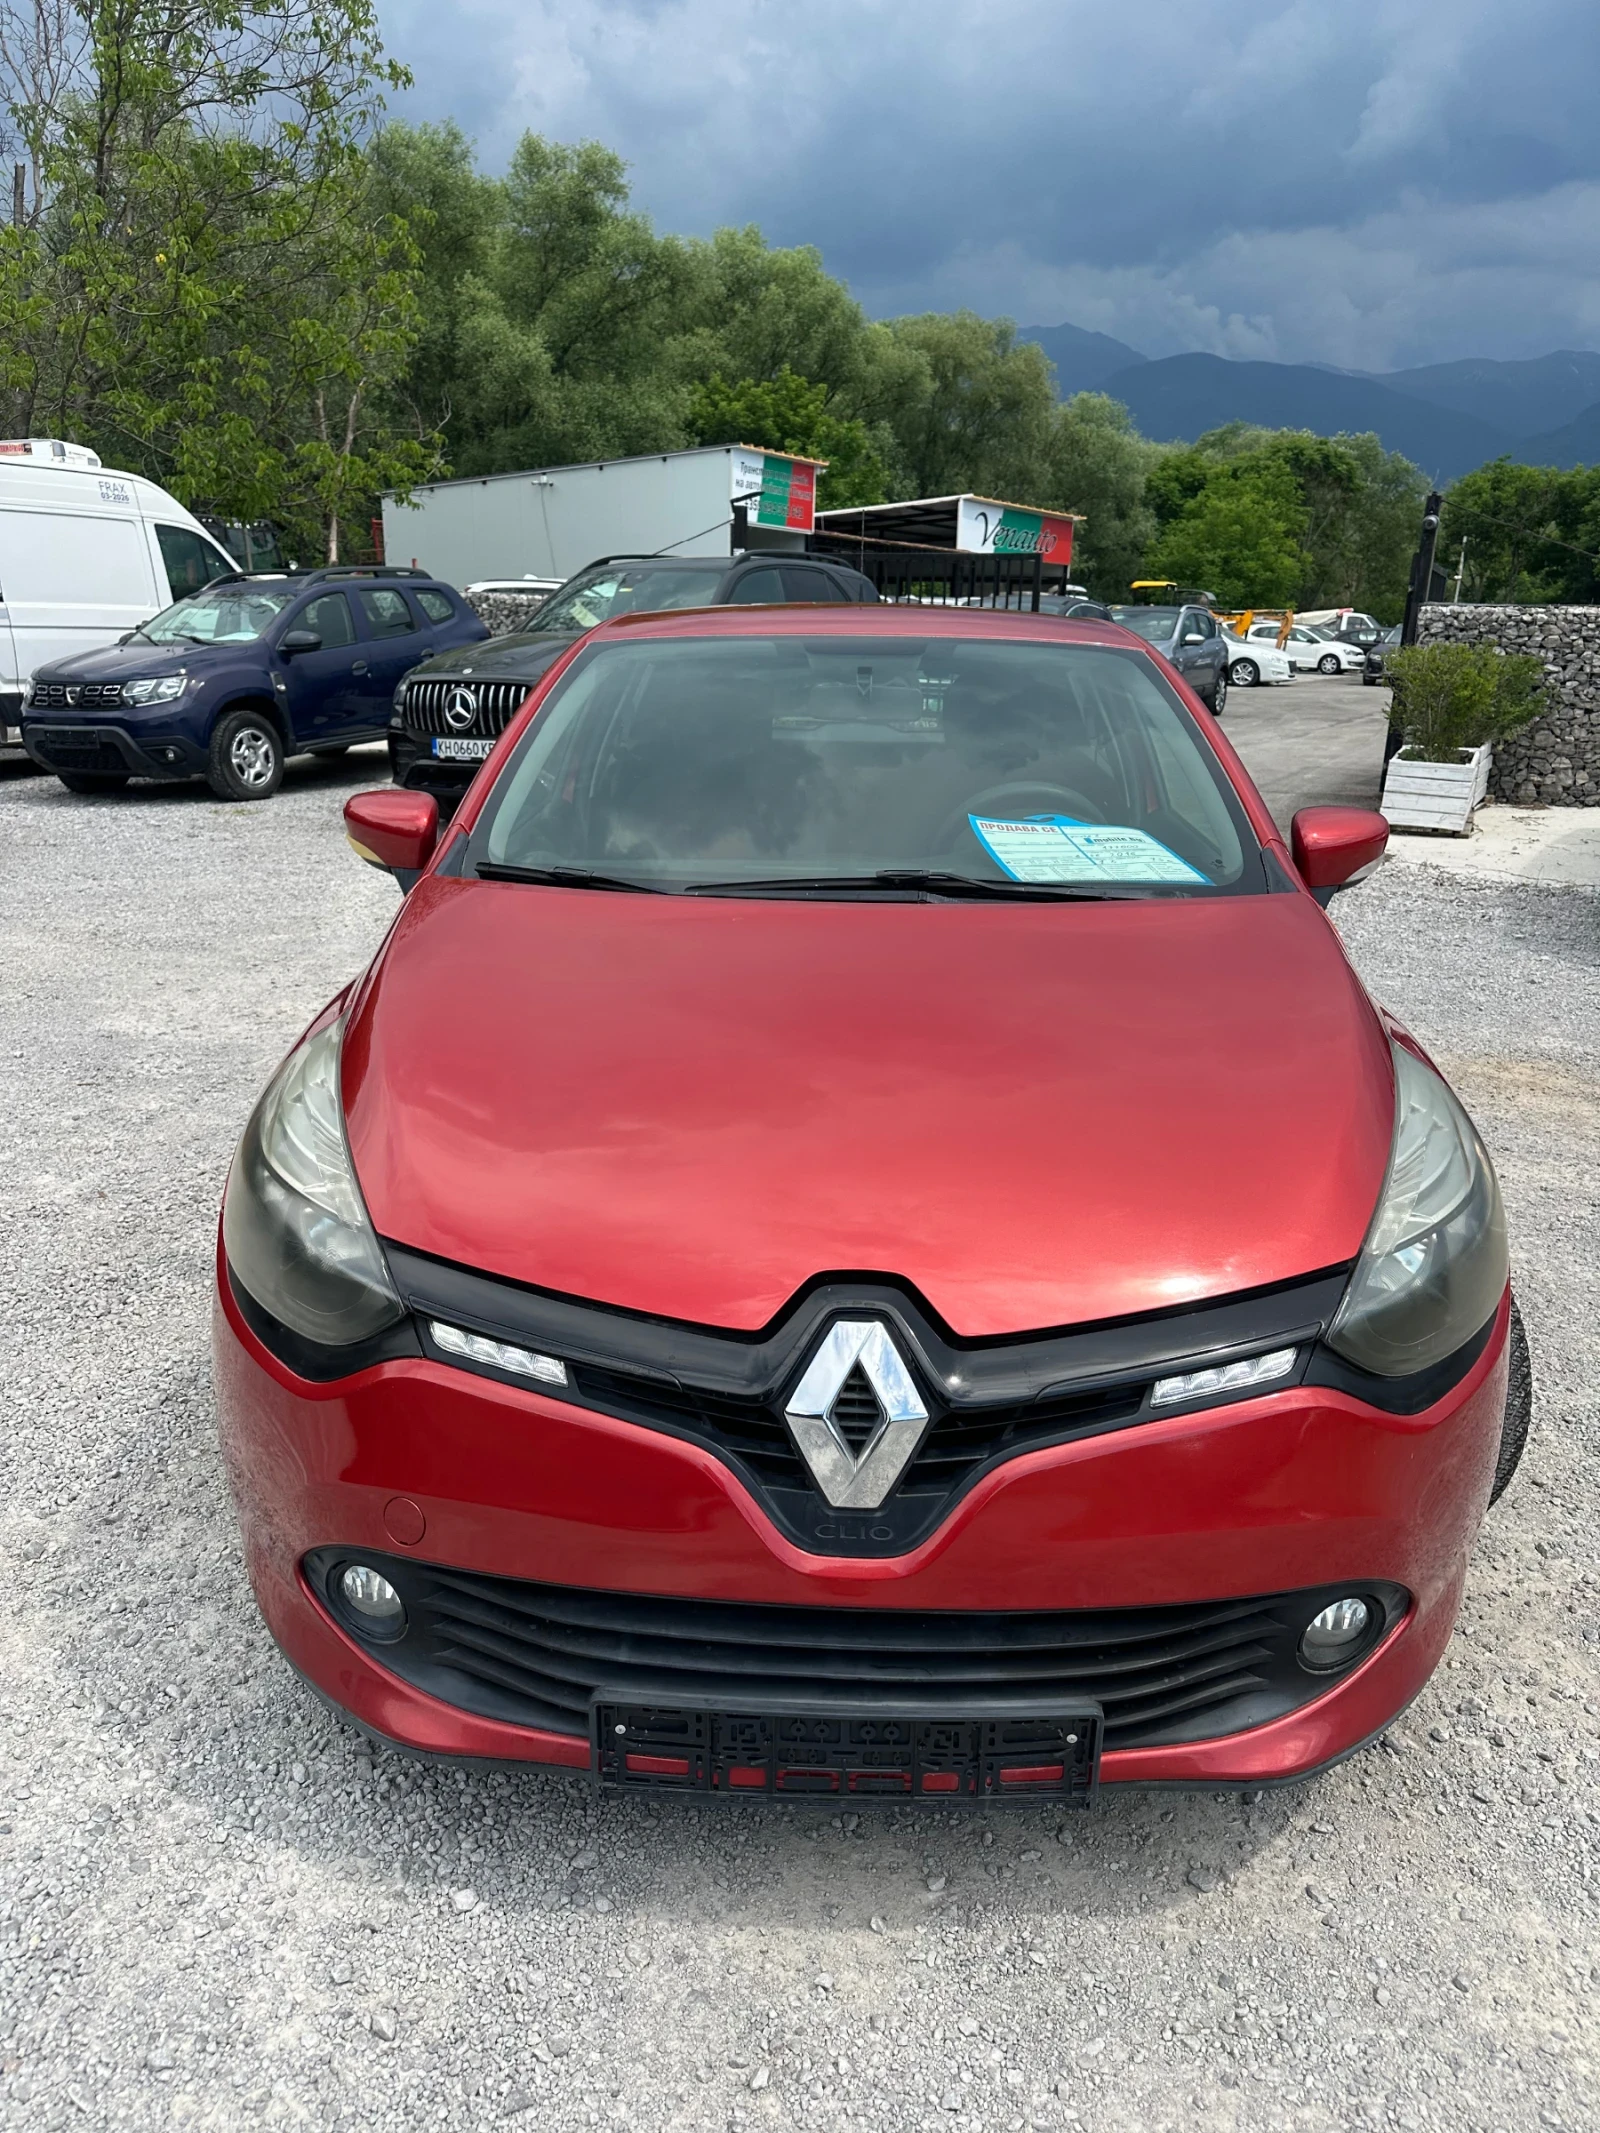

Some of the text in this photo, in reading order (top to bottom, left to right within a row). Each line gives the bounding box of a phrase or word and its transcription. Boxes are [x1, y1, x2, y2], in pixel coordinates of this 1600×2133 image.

[98, 481, 127, 494] FRAX
[975, 511, 1058, 554] Venauto
[437, 740, 452, 754] KH
[453, 741, 480, 756] 0660
[979, 821, 1039, 833] ПРОДАВА
[814, 1524, 894, 1541] CLIO
